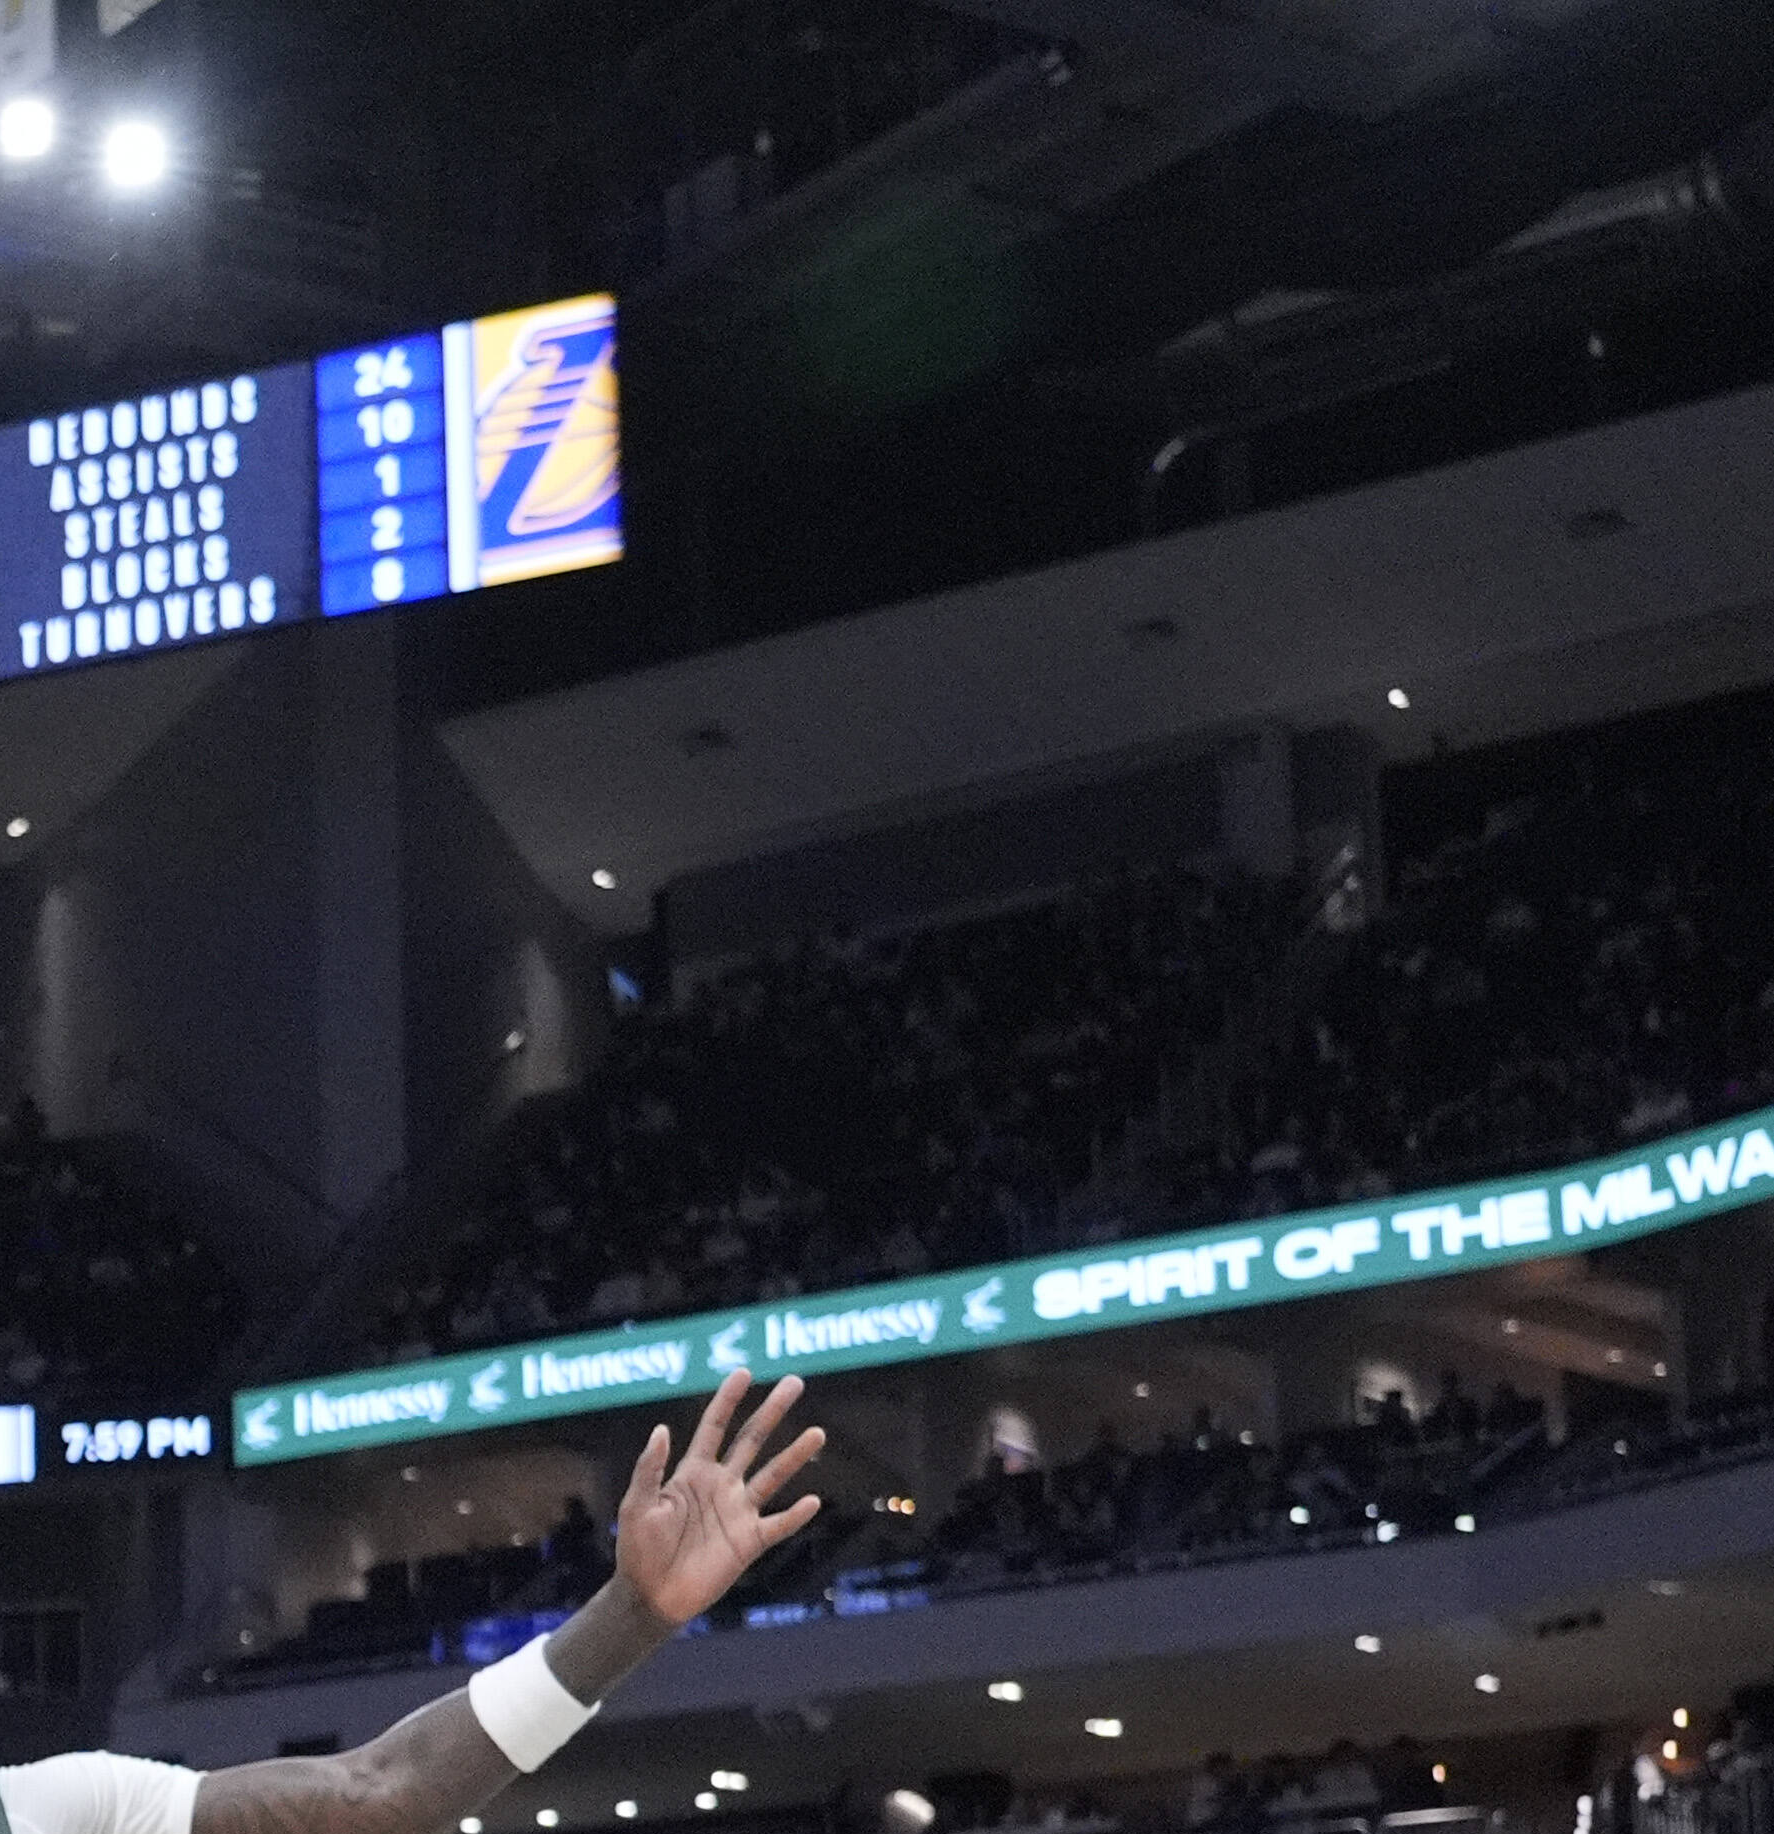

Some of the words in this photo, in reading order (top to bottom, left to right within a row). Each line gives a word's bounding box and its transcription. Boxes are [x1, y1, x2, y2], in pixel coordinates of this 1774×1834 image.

[30, 375, 258, 467] REBOUNDS
[354, 346, 413, 397] 24
[50, 432, 239, 512] ASSISTS
[356, 398, 414, 448] 10
[61, 535, 230, 611] BLOCKS
[371, 506, 403, 551] 2
[64, 486, 224, 559] STEALS
[374, 455, 401, 498] 1
[19, 576, 276, 668] TURNOVERS
[292, 1380, 451, 1437] Hennessy
[521, 1340, 688, 1399] Hennessy
[765, 1299, 941, 1359] Hennessy
[1033, 1237, 1263, 1321] SPIRIT
[1273, 1217, 1381, 1281] OF
[1391, 1188, 1552, 1261] THE
[1560, 1127, 1774, 1237] MILWA
[61, 1421, 143, 1463] 7:59
[146, 1415, 212, 1459] PM
